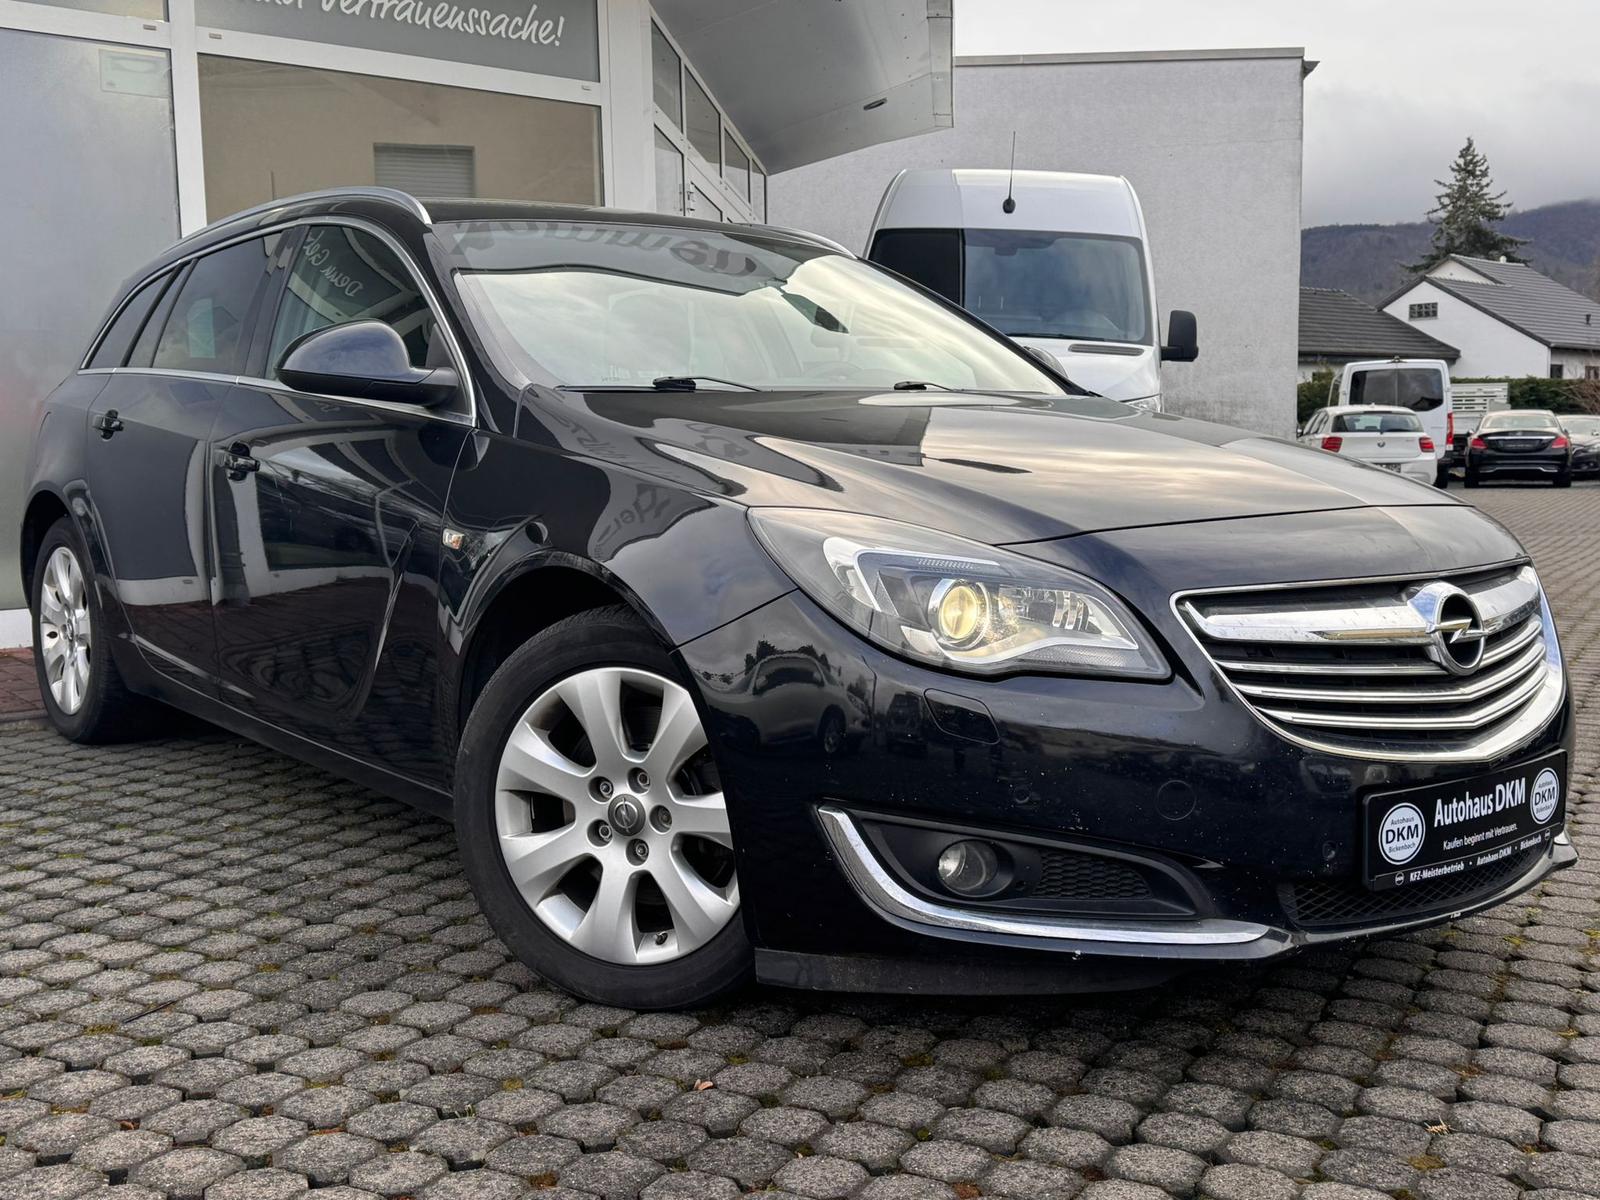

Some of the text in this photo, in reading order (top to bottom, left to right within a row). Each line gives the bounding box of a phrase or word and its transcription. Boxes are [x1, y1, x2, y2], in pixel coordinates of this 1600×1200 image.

[1434, 777, 1526, 827] Autohaus DKM
[1534, 786, 1556, 806] DKM
[1390, 815, 1415, 826] Autohaus
[1385, 823, 1419, 844] DKM
[1443, 837, 1464, 851] Kaufen
[1464, 832, 1485, 847] beginnt
[1485, 829, 1494, 841] mit
[1409, 861, 1465, 882] KFZ-Meisterbetrieb
